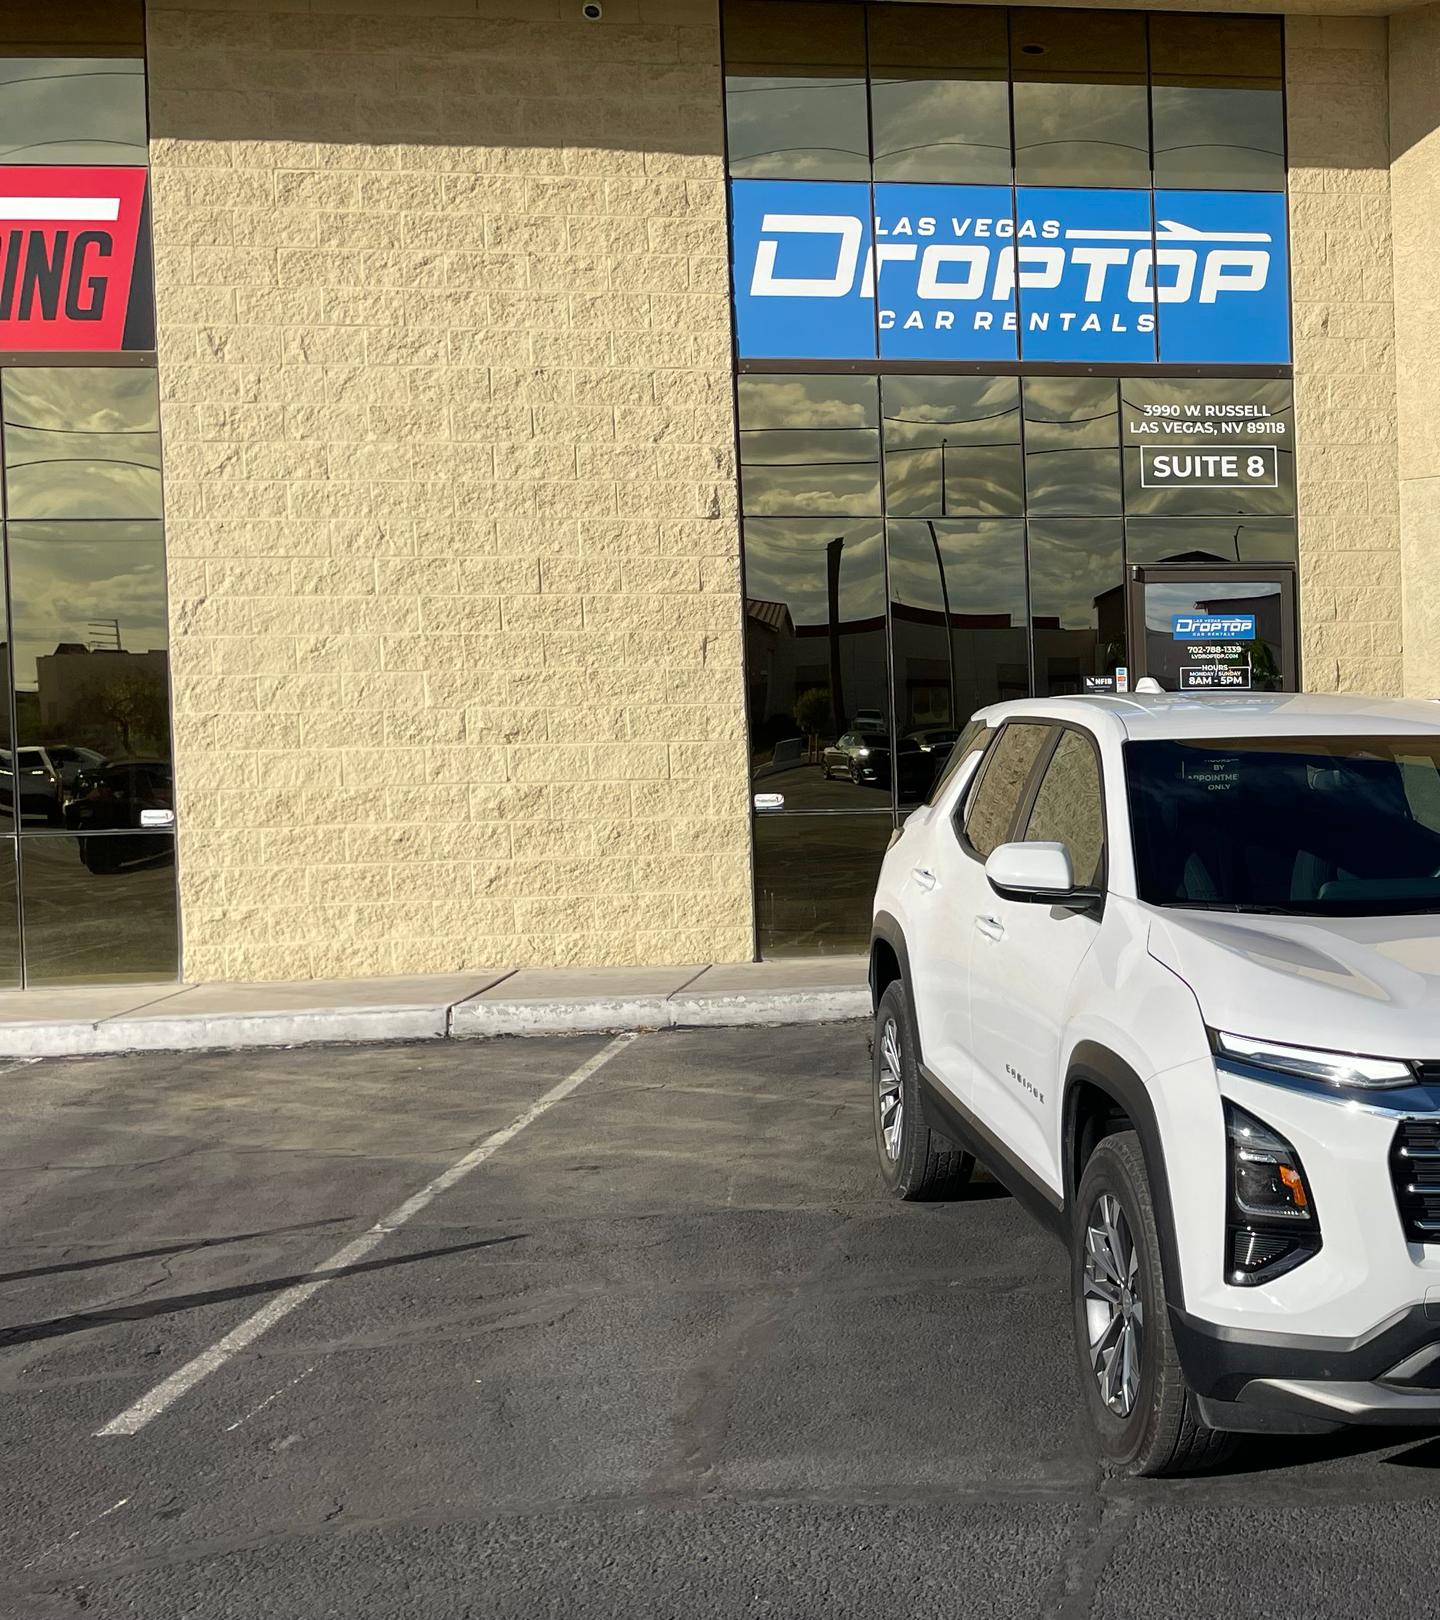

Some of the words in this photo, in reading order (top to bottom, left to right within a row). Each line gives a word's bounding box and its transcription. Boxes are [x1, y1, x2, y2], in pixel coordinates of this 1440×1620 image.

[874, 217, 936, 236] LAS
[951, 217, 1061, 238] VEGAS
[0, 230, 113, 321] ING
[878, 310, 955, 329] CAR
[973, 311, 1155, 332] RENTALS
[1143, 405, 1180, 417] 3990
[1205, 405, 1271, 417] RUSSELL
[1130, 421, 1159, 434] LAS
[1162, 421, 1218, 436] VEGAS,
[1221, 422, 1243, 434] NV
[1247, 422, 1286, 434] 89118
[1153, 455, 1239, 478] SUITE
[1246, 455, 1265, 478] 8
[1187, 646, 1242, 654] 702-788-1339
[1095, 677, 1113, 685] NFIB
[1188, 676, 1212, 685] 8AM
[1220, 676, 1243, 685] 5PM
[1207, 783, 1231, 791] ONLY
